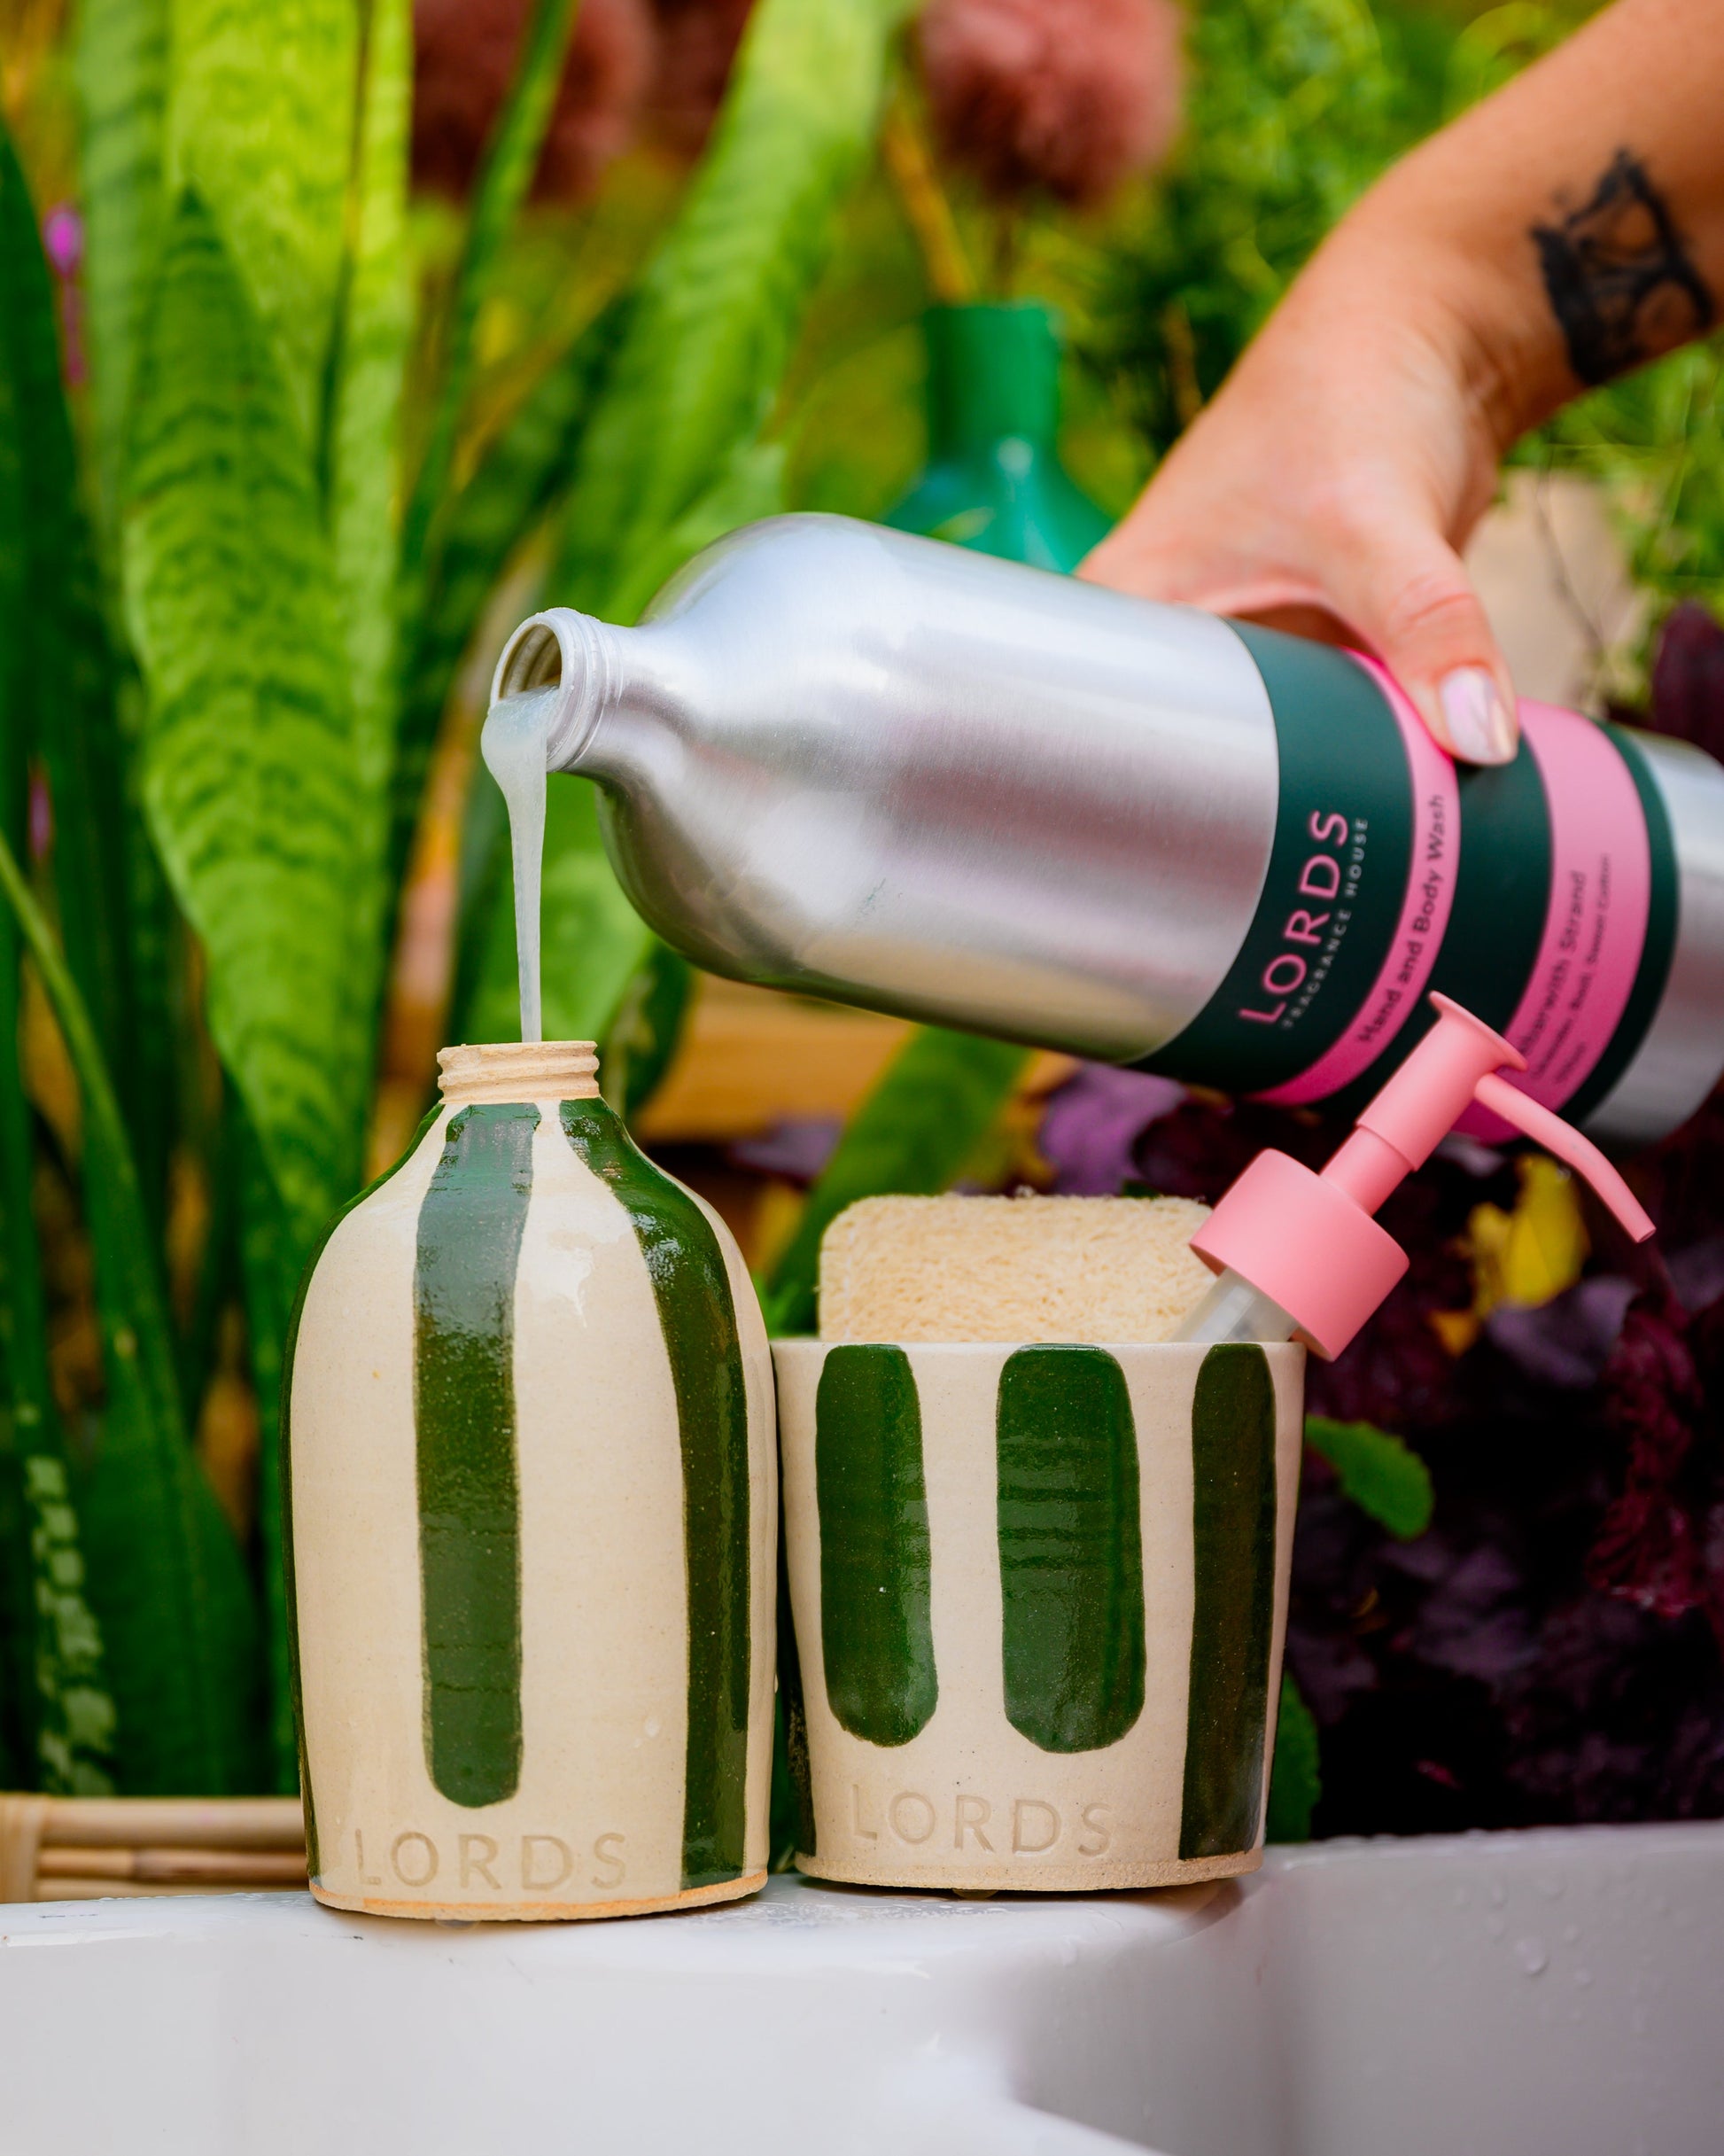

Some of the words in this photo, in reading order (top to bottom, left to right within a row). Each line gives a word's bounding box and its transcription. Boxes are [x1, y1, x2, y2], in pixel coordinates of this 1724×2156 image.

[1426, 794, 1446, 862] Wash
[1239, 810, 1349, 1025] LORDS
[1281, 908, 1352, 1029] FRAGRANCE
[1344, 817, 1369, 898] HOUSE
[1413, 869, 1445, 934] Body
[1559, 869, 1587, 953] Strand
[1399, 941, 1424, 985] and
[1357, 988, 1402, 1043] Hand
[852, 1783, 1113, 1857] LORDS
[353, 1828, 627, 1890] LORDS
